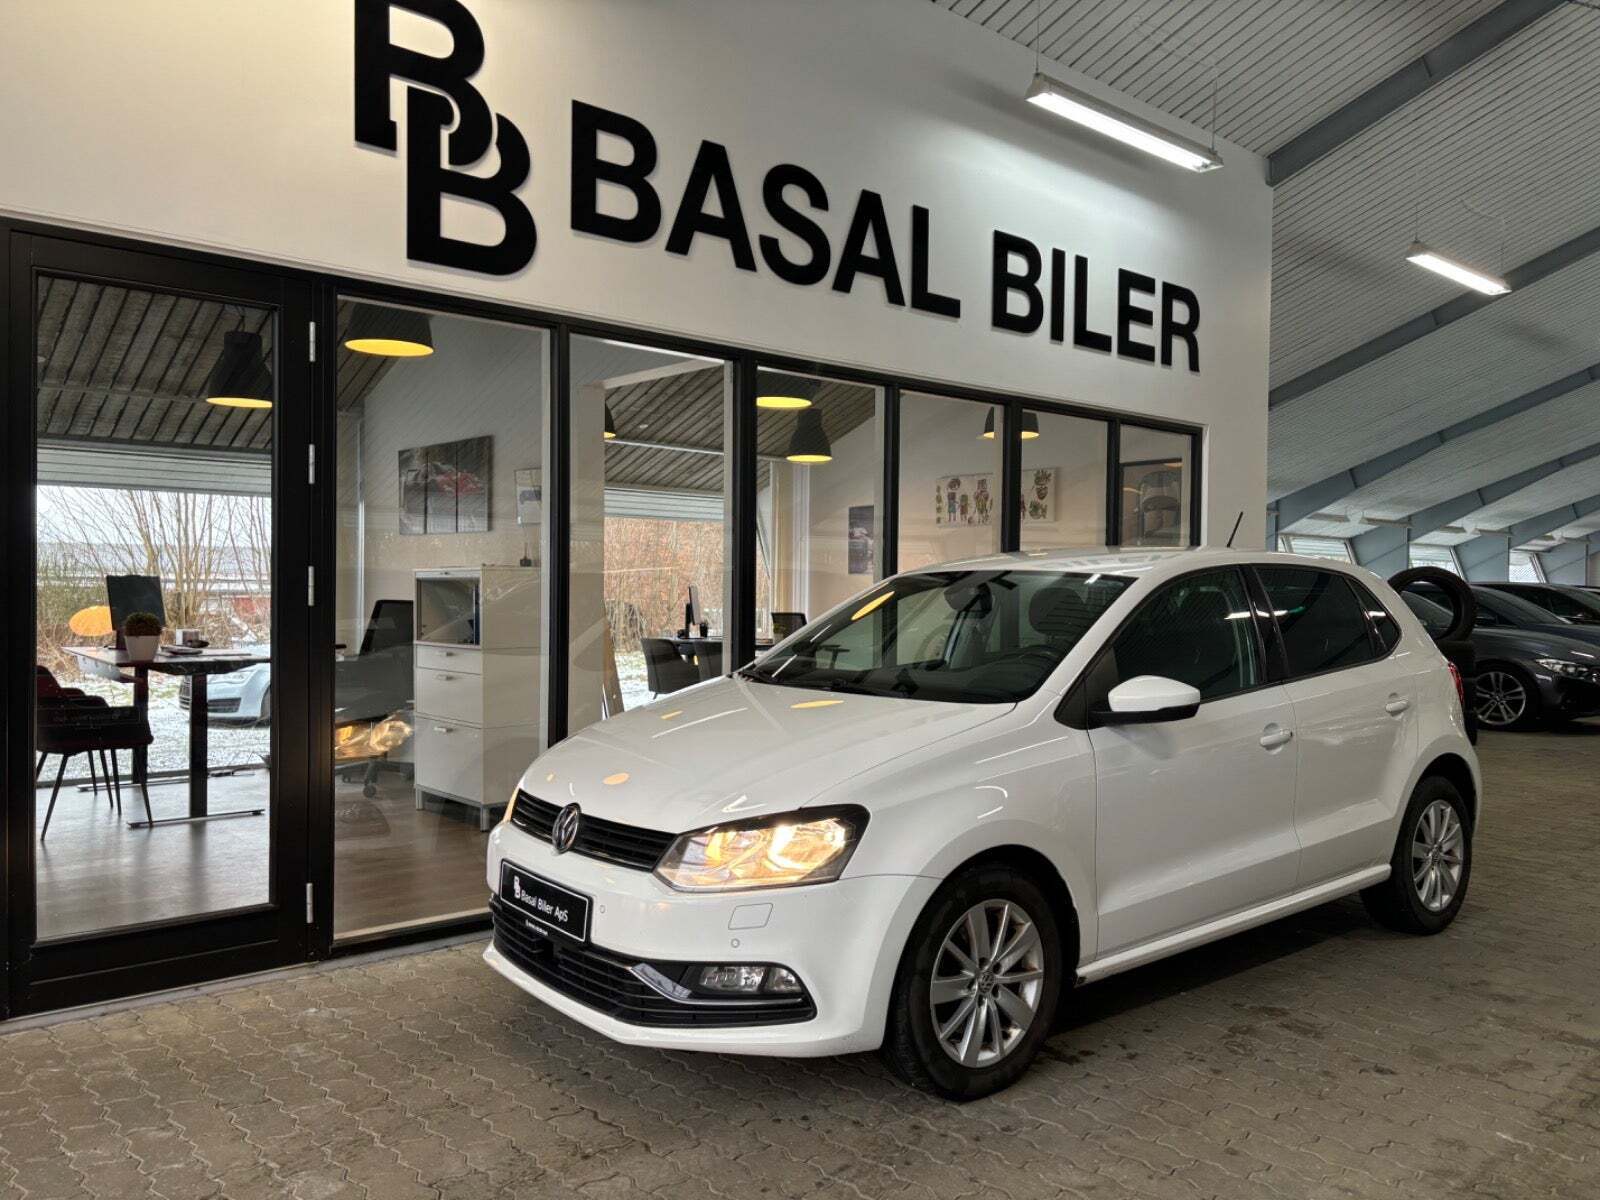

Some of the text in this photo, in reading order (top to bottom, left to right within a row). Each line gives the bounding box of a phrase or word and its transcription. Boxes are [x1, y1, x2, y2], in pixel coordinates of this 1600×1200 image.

[571, 100, 1201, 373] BASAL BILER
[538, 898, 553, 915] Biler
[554, 906, 568, 922] ApS
